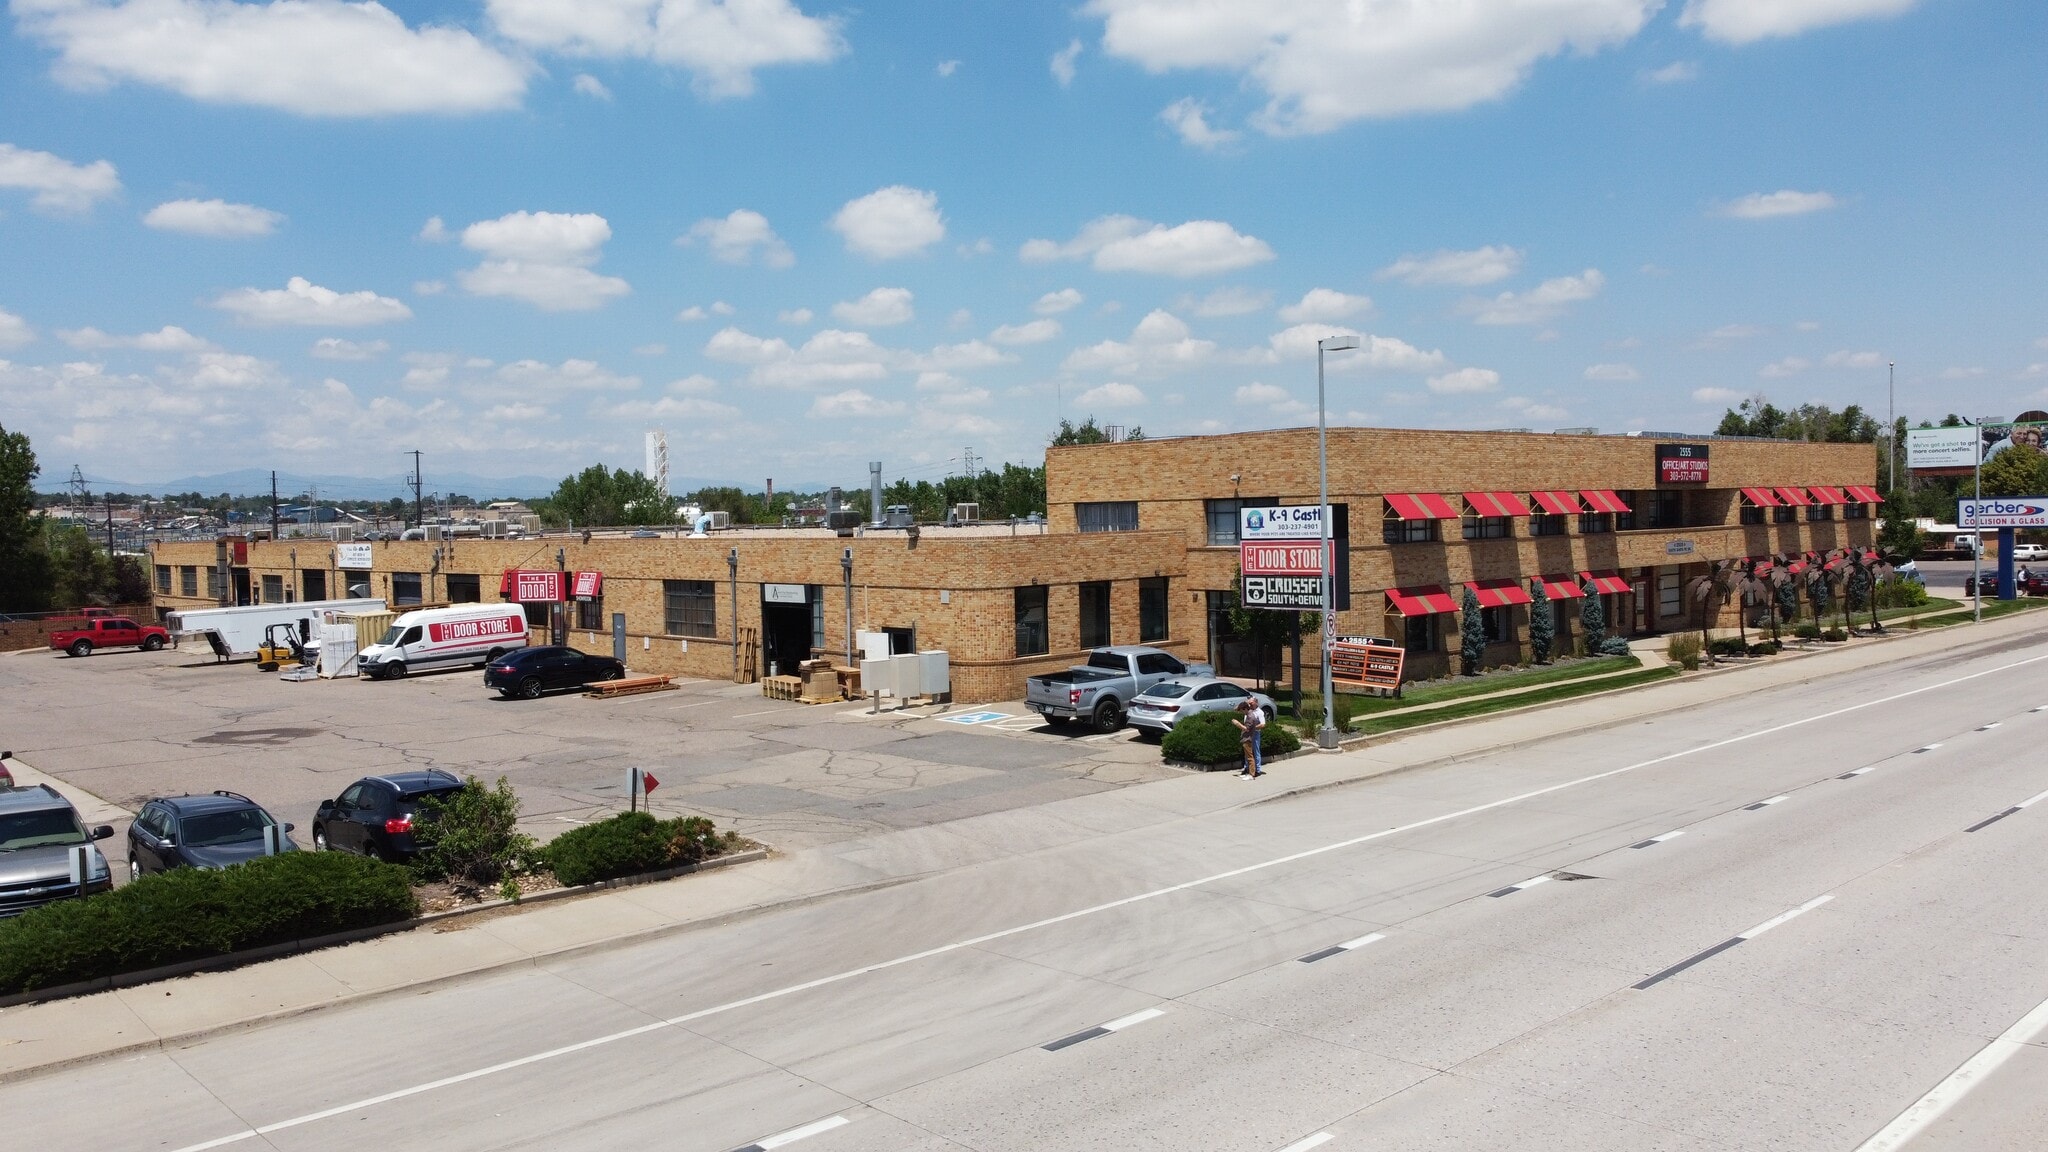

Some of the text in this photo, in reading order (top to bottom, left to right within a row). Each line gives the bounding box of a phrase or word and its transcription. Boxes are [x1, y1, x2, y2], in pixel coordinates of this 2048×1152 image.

[1680, 447, 1692, 456] 2555
[1690, 461, 1708, 470] STUDIOS
[1269, 508, 1321, 521] K-9 Castl
[1964, 501, 2024, 518] gerber
[1258, 549, 1286, 569] DOOR
[521, 584, 545, 598] DOOR
[1267, 578, 1322, 594] CROSSFI
[1298, 595, 1322, 605] DENVE
[454, 620, 509, 638] DOOR STORE
